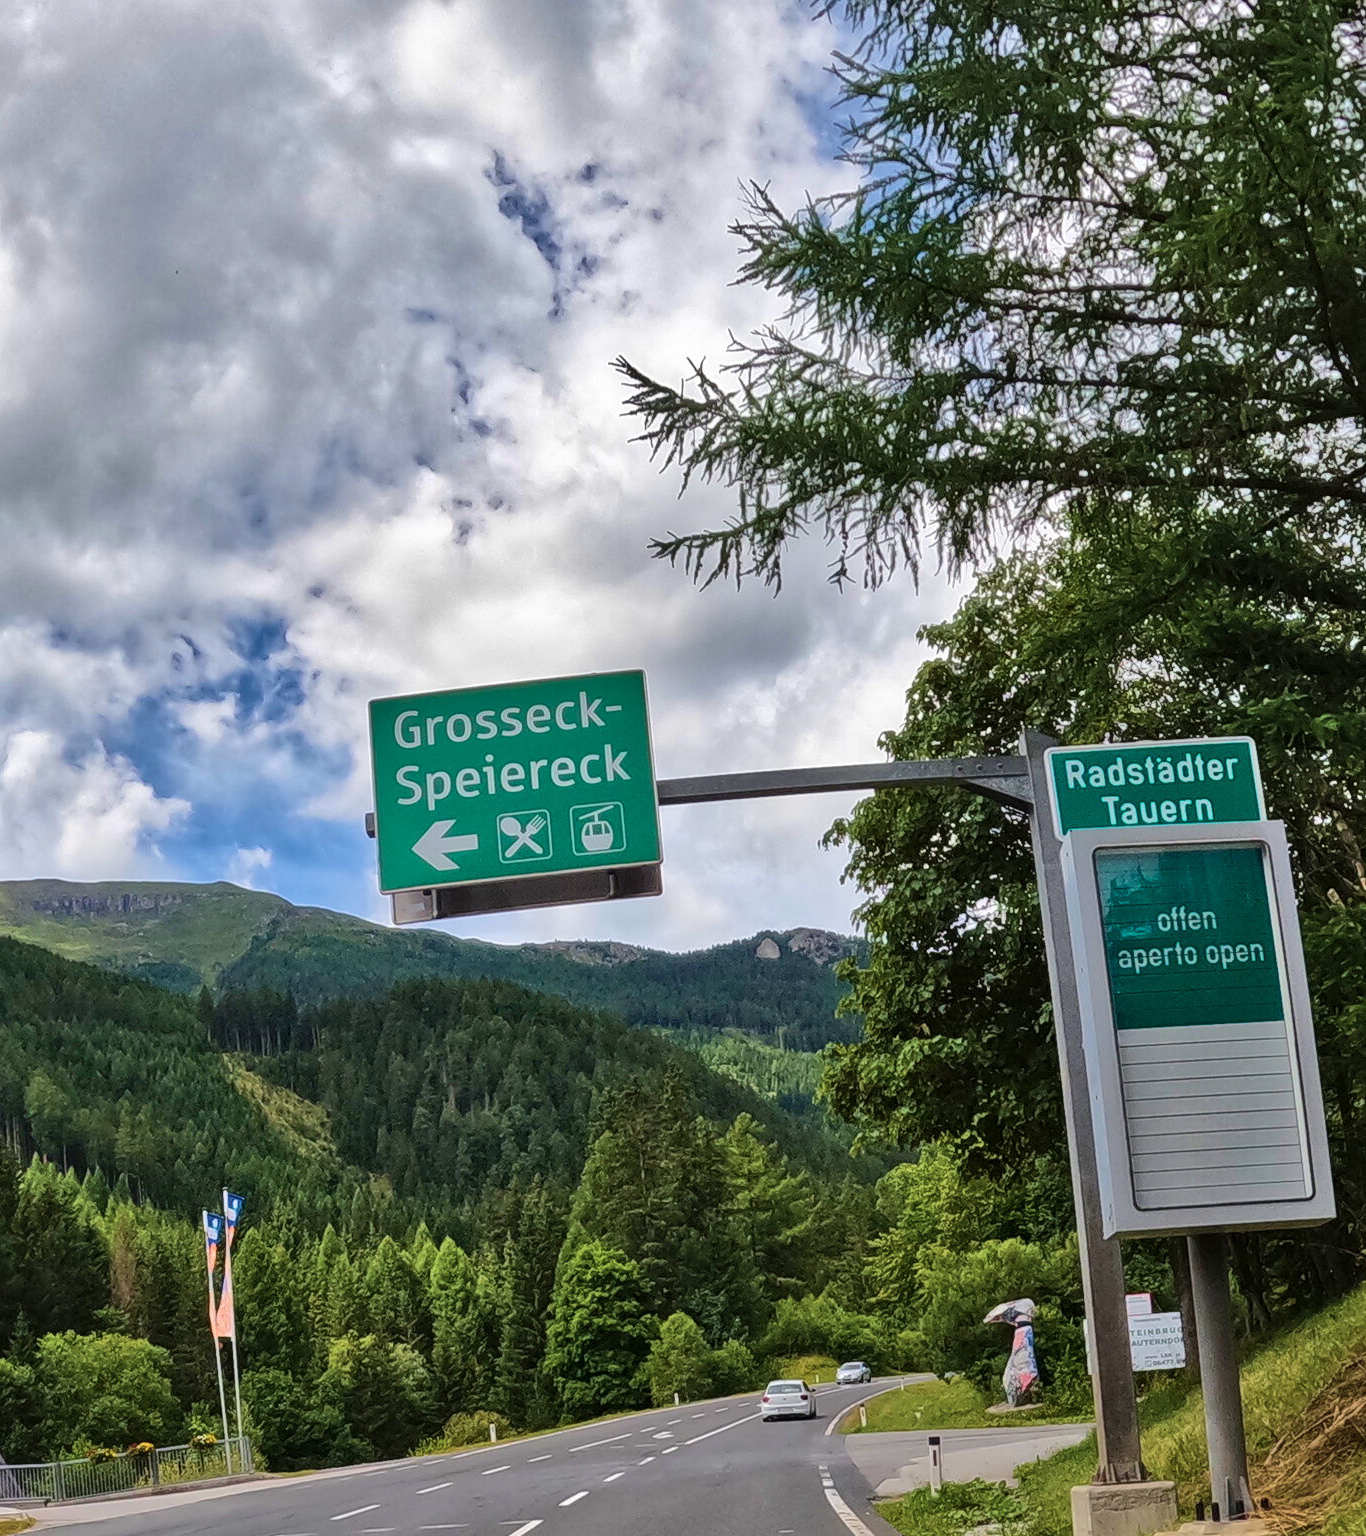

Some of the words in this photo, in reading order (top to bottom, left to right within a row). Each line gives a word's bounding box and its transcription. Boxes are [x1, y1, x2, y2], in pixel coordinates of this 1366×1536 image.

[394, 691, 623, 749] Grosseck-
[395, 743, 631, 811] Speiereck
[1065, 753, 1239, 789] Radstädter
[1101, 796, 1214, 825] Tauern
[1157, 905, 1218, 932] offen
[1117, 941, 1198, 974] aperto
[1206, 942, 1265, 969] open
[1130, 1327, 1183, 1337] TEINBRUC
[1131, 1337, 1183, 1347] AUTERNDO
